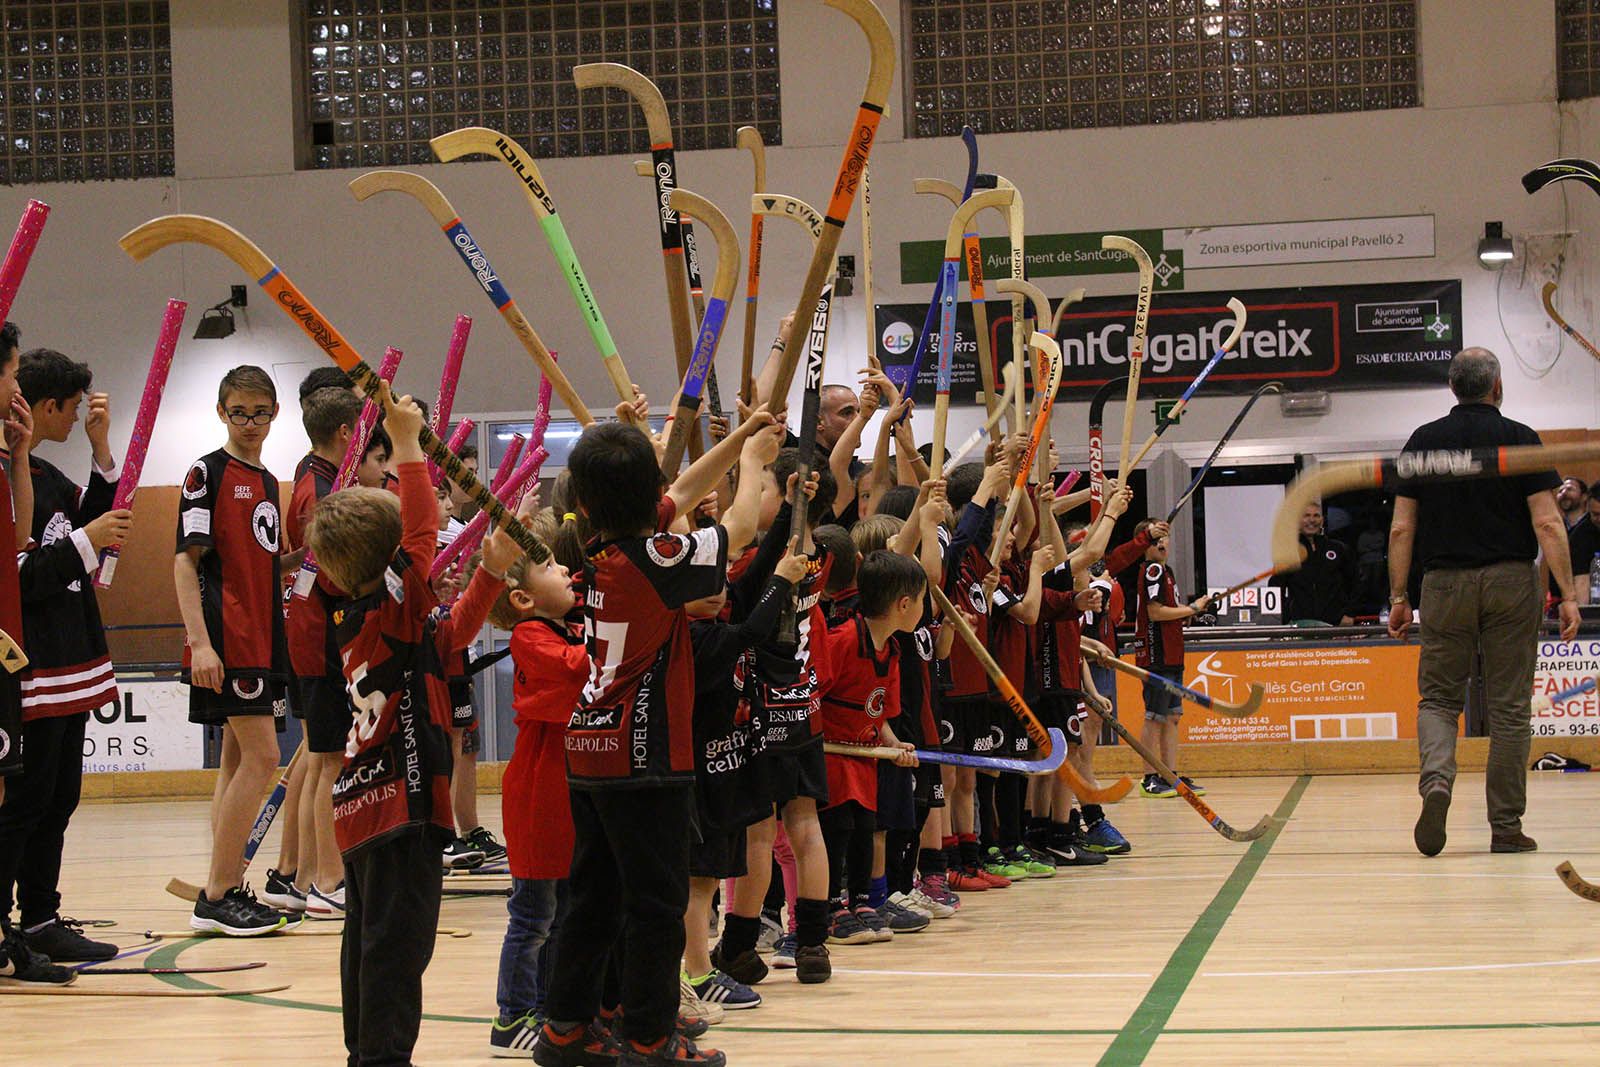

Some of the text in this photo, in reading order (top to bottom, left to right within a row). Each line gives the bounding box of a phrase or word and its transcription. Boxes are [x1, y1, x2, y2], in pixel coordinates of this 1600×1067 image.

[656, 161, 678, 234] Reno
[1199, 233, 1404, 256] Zona esportiva municipal Pavelló 2
[454, 232, 499, 293] Reno
[987, 250, 1054, 268] Ajunment
[1057, 250, 1072, 262] de
[1135, 285, 1148, 340] AZEMAD
[1371, 316, 1423, 326] de SantCugat
[1374, 307, 1420, 317] Ajuntament
[278, 289, 342, 361] Reno
[930, 342, 977, 353] SRTS
[1022, 319, 1313, 374] ntCugatCreix
[1356, 350, 1452, 364] ESADECREAPOLIS
[586, 585, 605, 611] ÀLEX
[1265, 590, 1277, 611] 0
[1537, 642, 1600, 658] OGA C
[1535, 660, 1600, 672] ERAPEUTA
[1246, 679, 1365, 694] Vllès Gent Gran
[86, 692, 147, 724] OL
[1531, 696, 1600, 718] ESCÈ
[400, 714, 417, 750] SANT
[1221, 717, 1231, 726] 93
[1232, 717, 1247, 725] 714
[1569, 723, 1600, 736] 93-6
[1188, 731, 1290, 742] www.vallesgentgran.com
[633, 727, 647, 769] HOTEL
[406, 751, 422, 793] HOTEL
[247, 803, 278, 845] Reno
